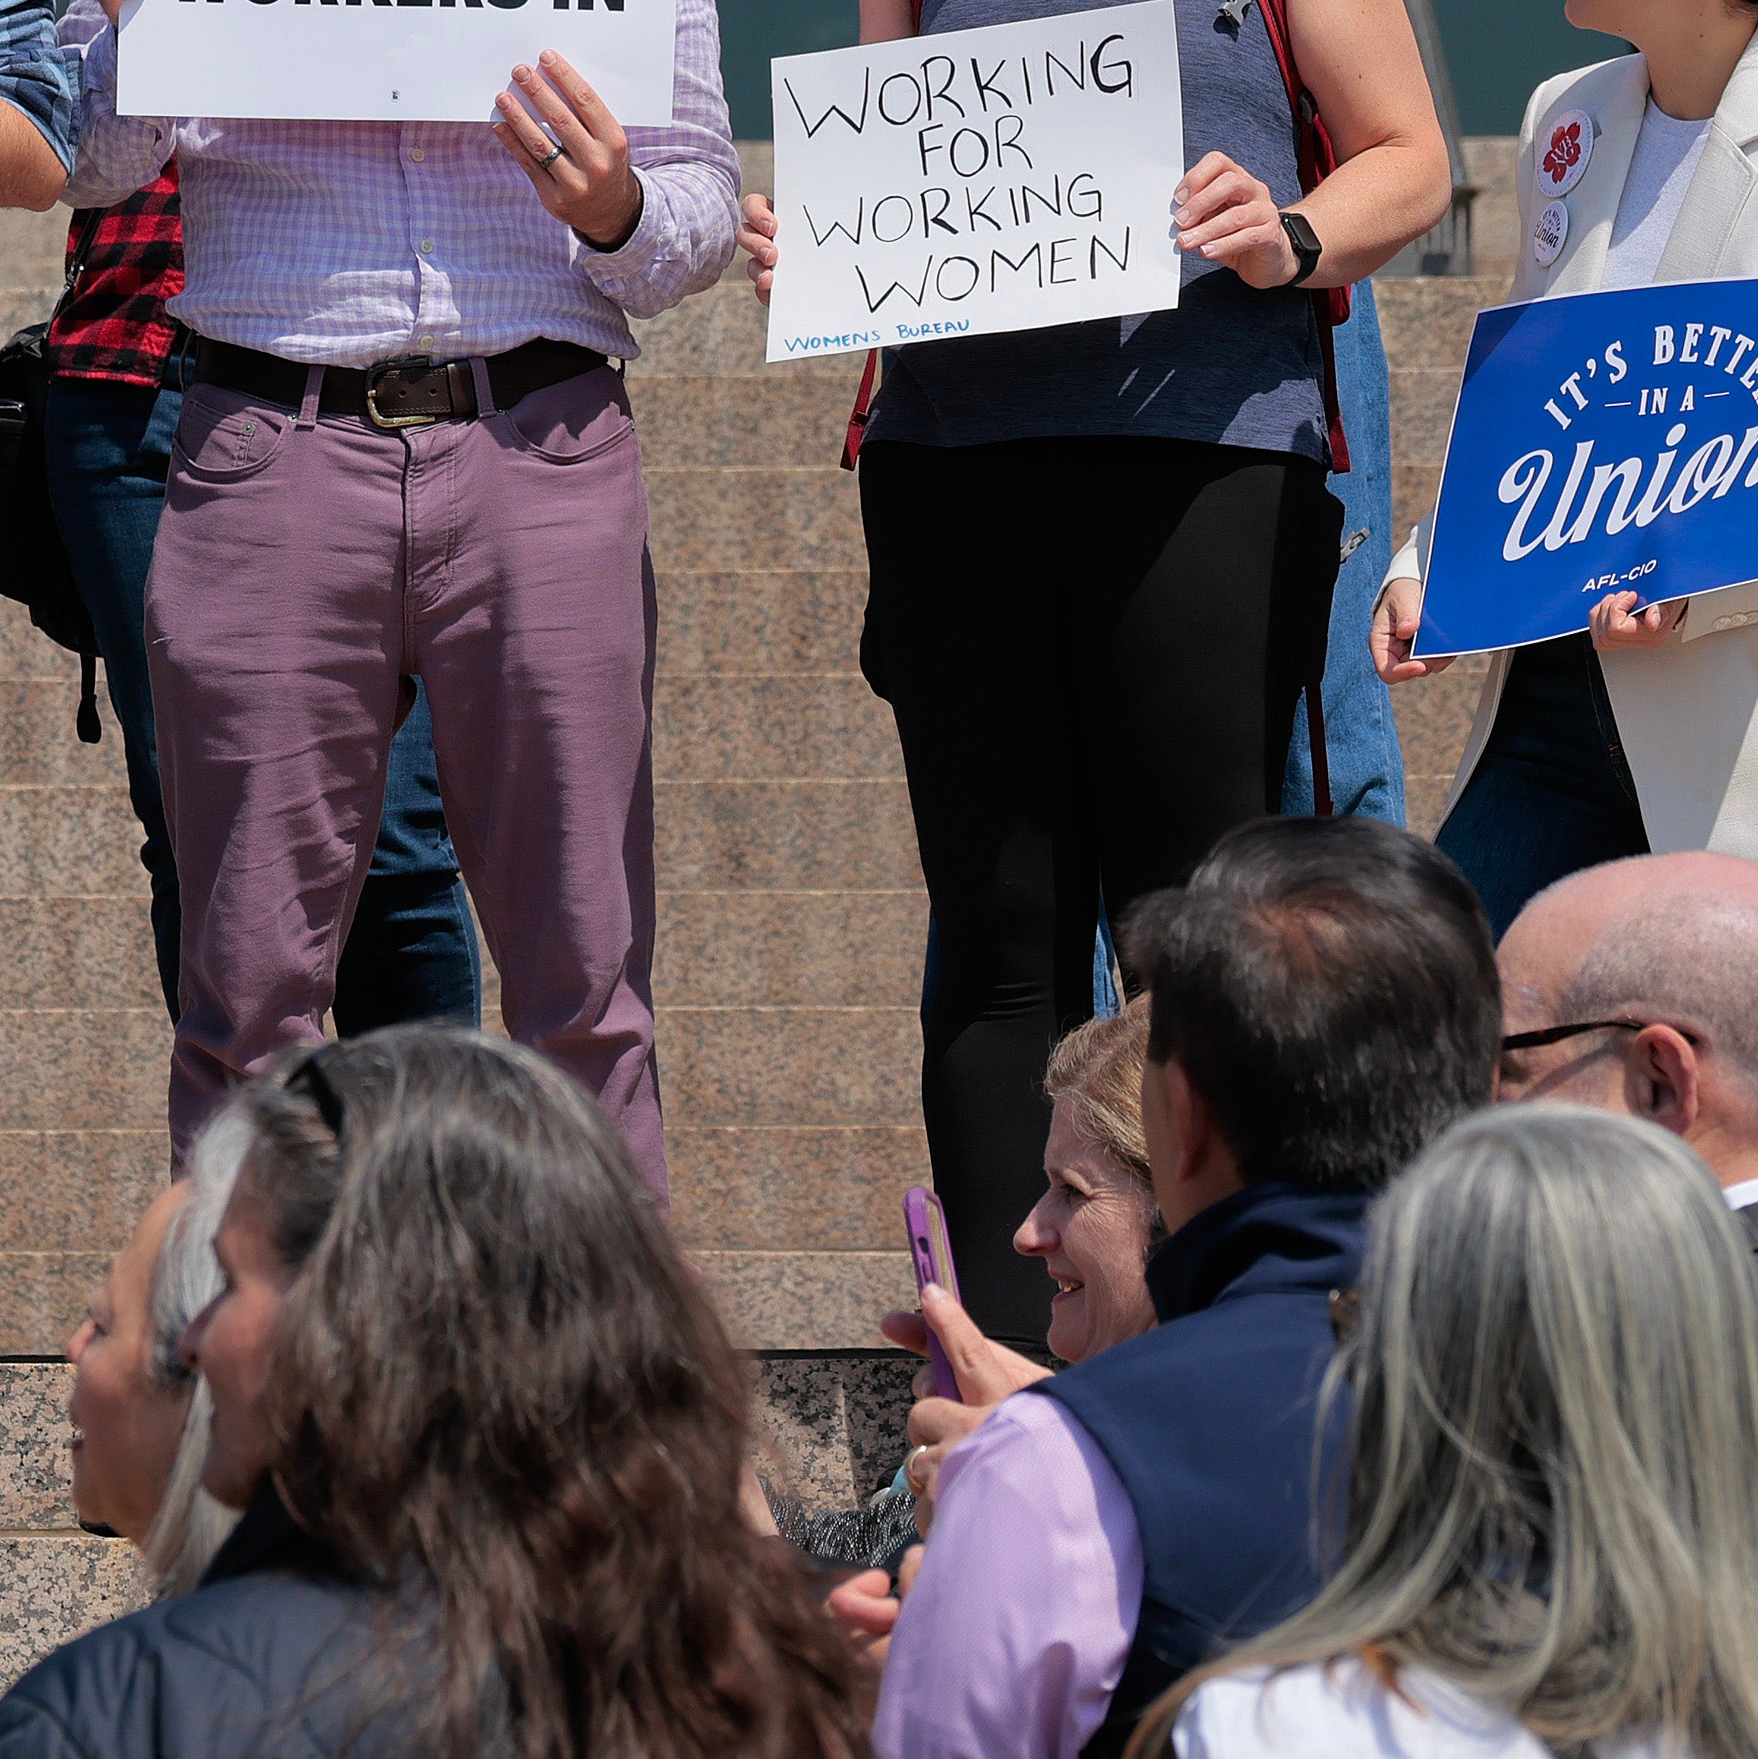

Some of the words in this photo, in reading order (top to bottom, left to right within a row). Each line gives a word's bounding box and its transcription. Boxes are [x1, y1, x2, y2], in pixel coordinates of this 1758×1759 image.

[784, 34, 1133, 139] WORKING
[917, 114, 1033, 178] FOR
[802, 173, 1103, 248] WORKING
[855, 226, 1130, 314] WOMEN
[784, 329, 881, 353] WOMENS
[896, 318, 970, 338] BUREAU
[1543, 339, 1629, 431] IT'S
[1637, 387, 1667, 416] IN
[1679, 384, 1696, 412] A
[1581, 558, 1658, 593] AFL-CIO
